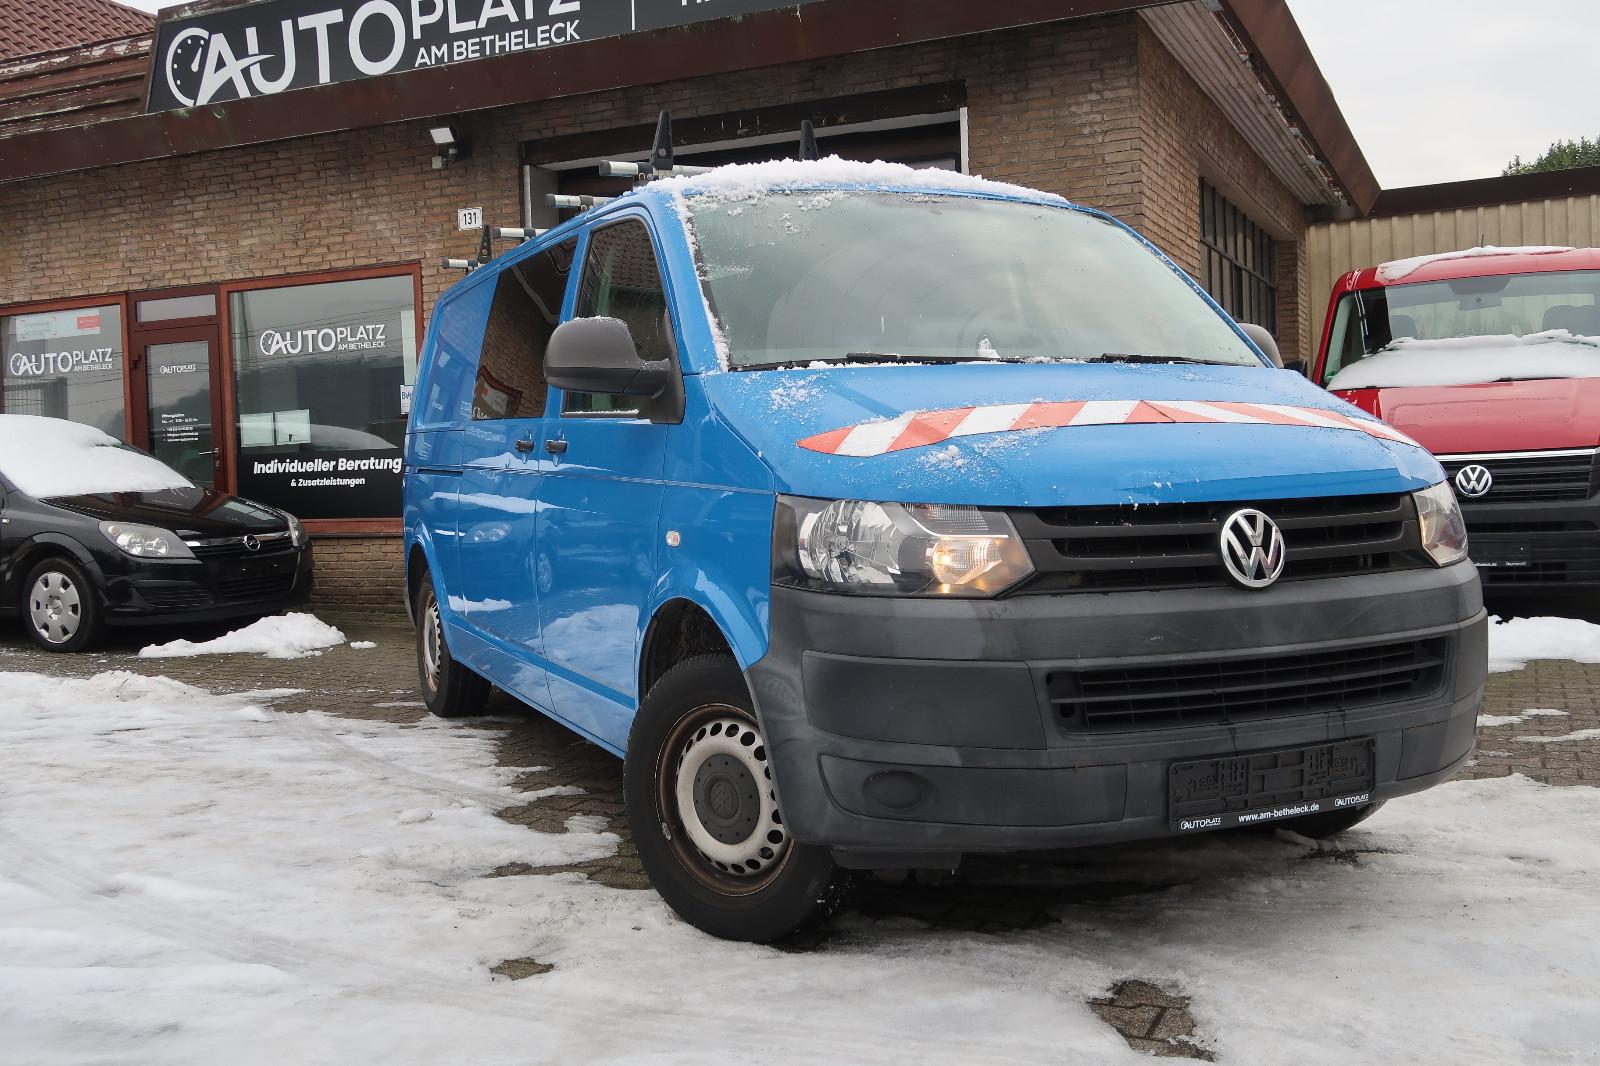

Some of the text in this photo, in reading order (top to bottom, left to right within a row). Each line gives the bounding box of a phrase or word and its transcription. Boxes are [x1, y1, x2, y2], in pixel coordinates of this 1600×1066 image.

[414, 19, 581, 67] AM BETHELECK
[463, 212, 477, 225] 131
[262, 323, 386, 356] AUTOPLATZ
[337, 340, 386, 351] AM BETHELECK
[13, 347, 113, 376] AUTOPLATZ
[253, 456, 403, 475] Individueller Beratung
[290, 476, 366, 488] & Zusatzleistungen
[1238, 803, 1320, 822] www.am-betheleck.de
